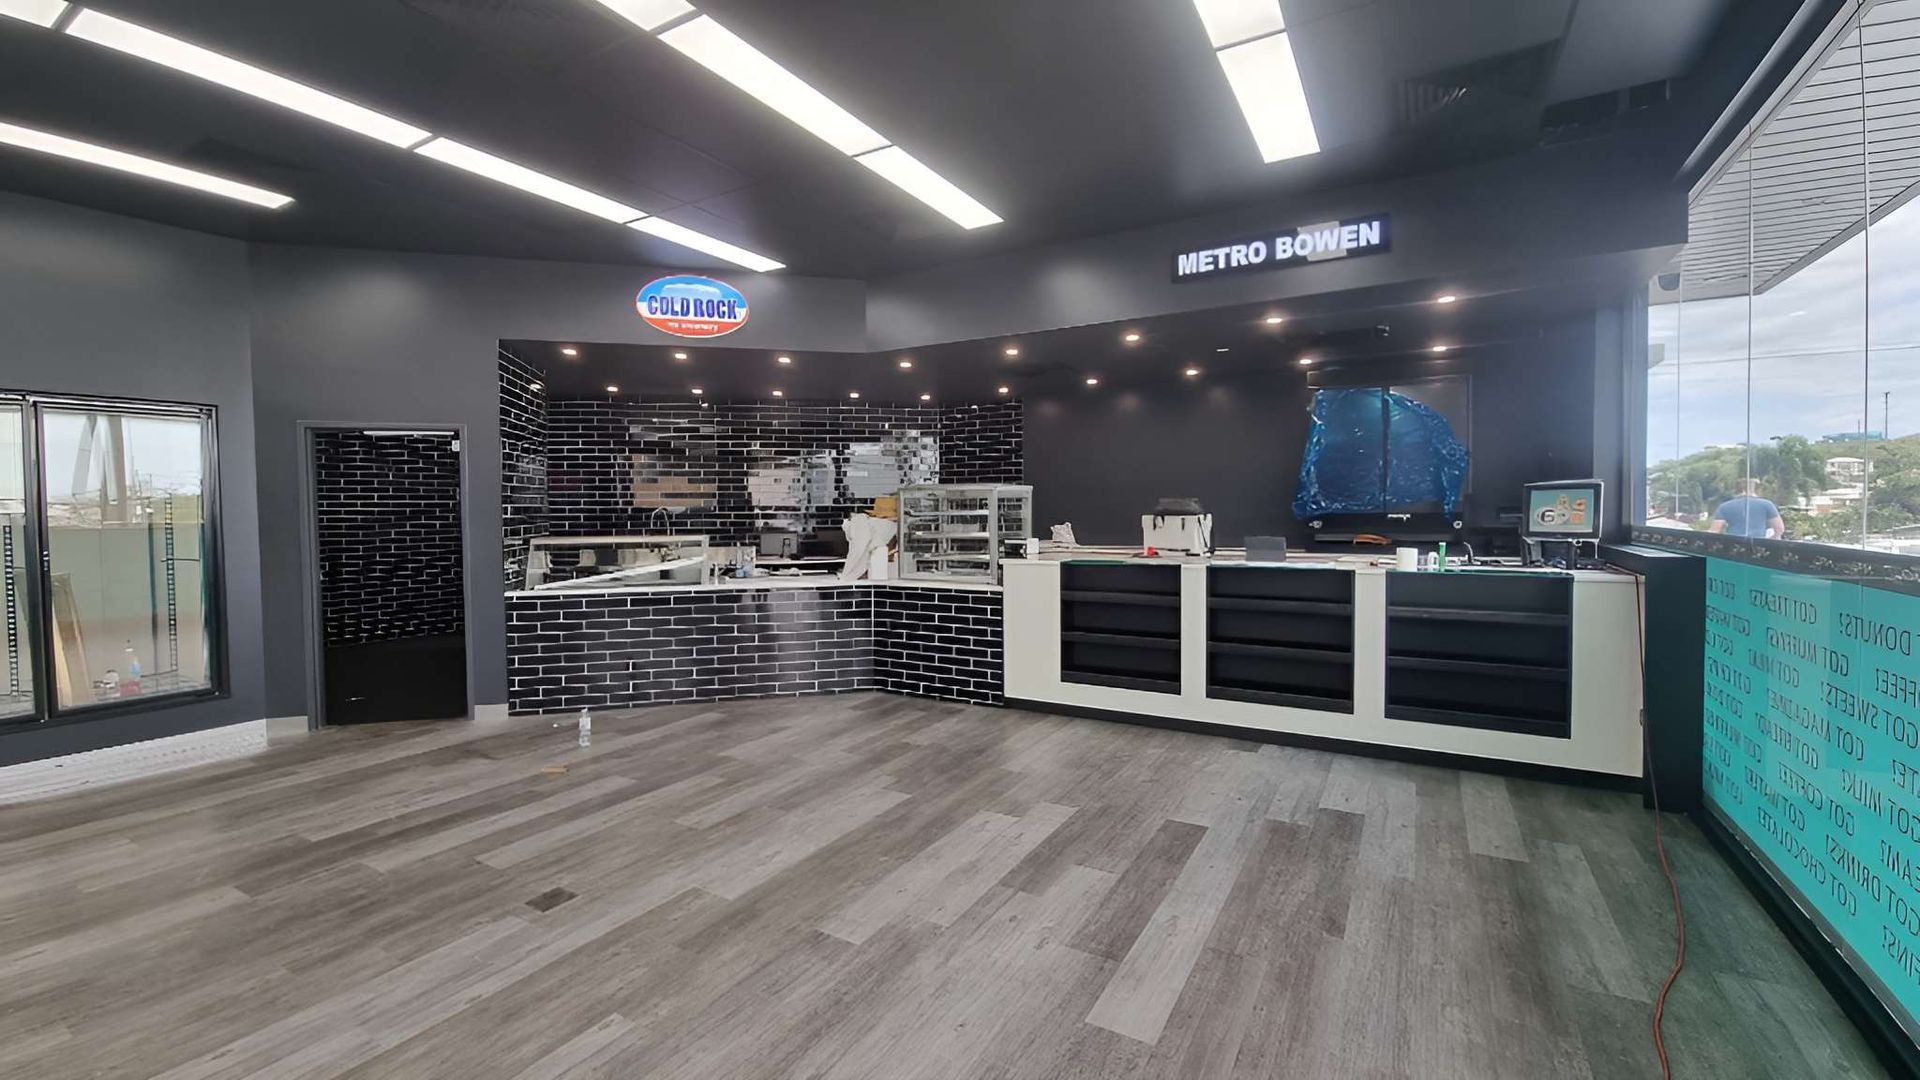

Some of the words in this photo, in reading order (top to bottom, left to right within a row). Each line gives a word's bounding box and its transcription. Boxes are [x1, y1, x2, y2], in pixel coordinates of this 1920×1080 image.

[1177, 241, 1267, 276] METRO
[1275, 220, 1380, 260] BOWEN
[647, 295, 691, 317] COLD
[694, 298, 737, 320] ROCK
